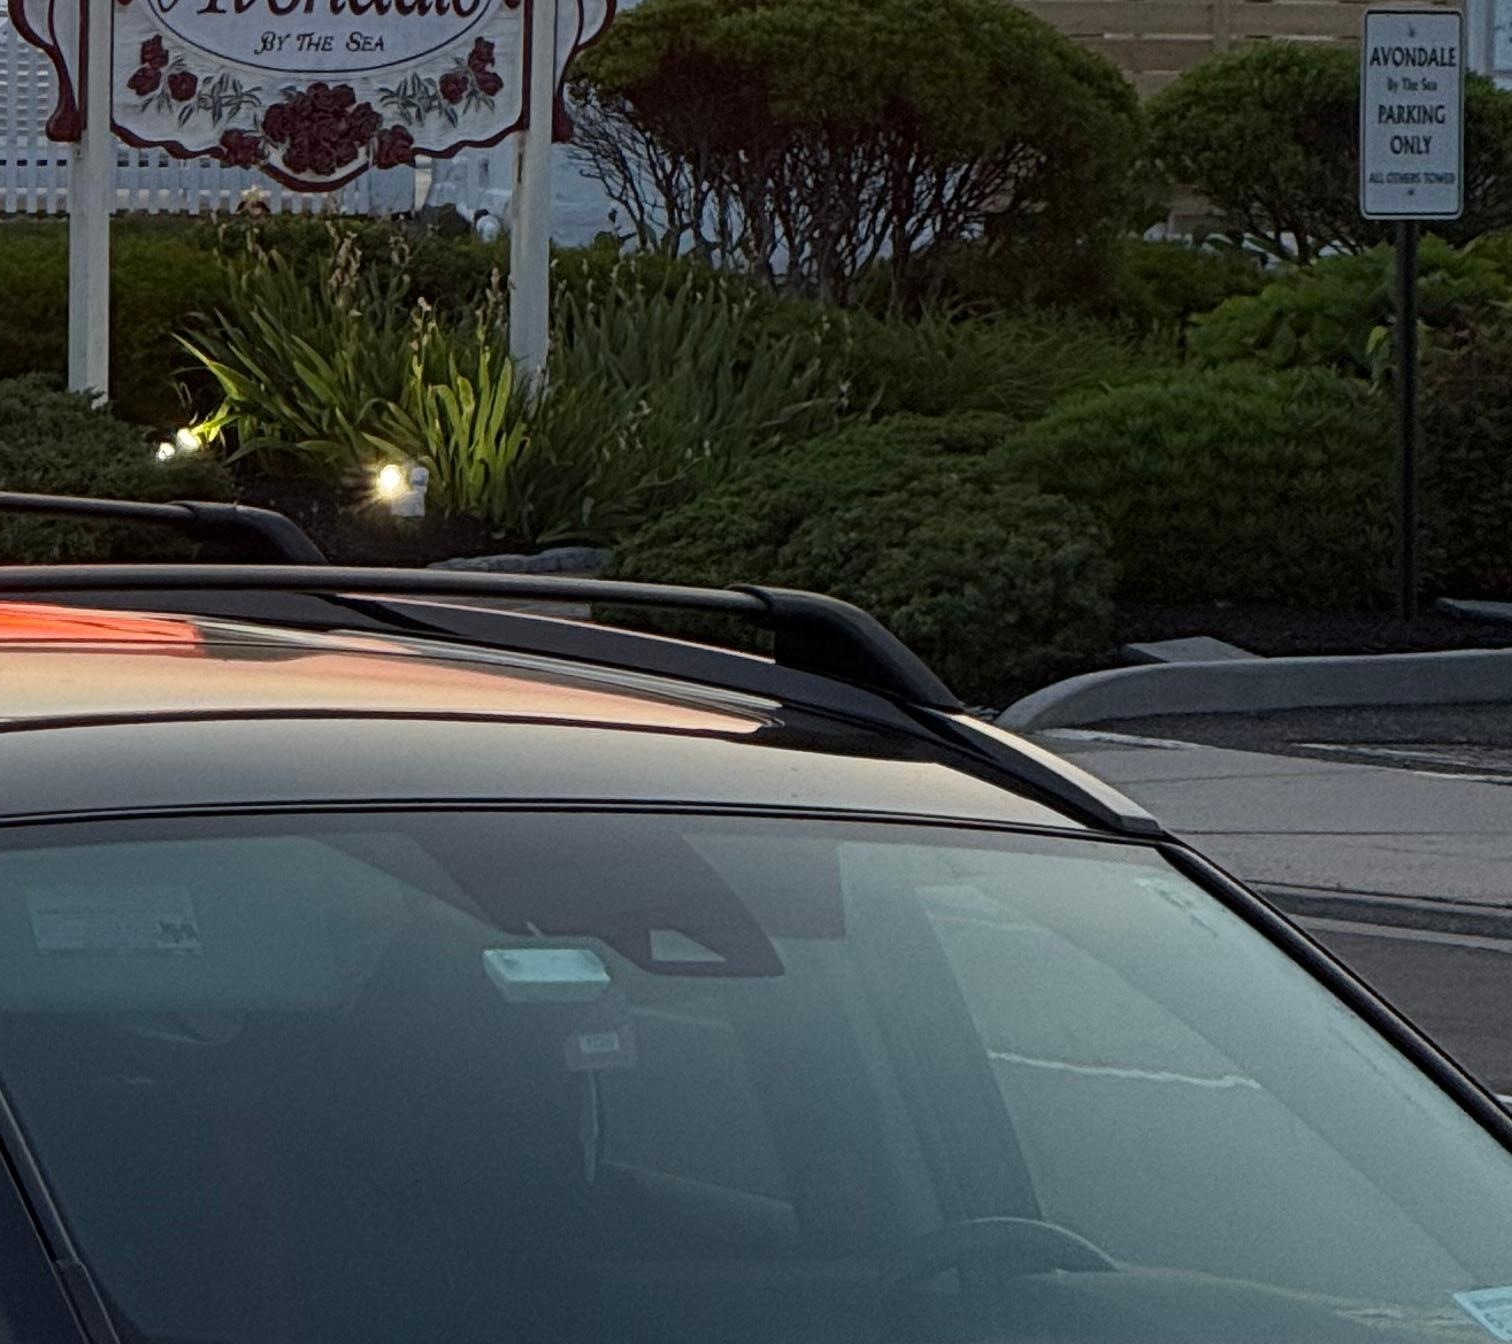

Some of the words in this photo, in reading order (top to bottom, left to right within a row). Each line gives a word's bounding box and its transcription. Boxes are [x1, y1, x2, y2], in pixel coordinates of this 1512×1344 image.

[1369, 46, 1457, 67] AVONDALE
[1402, 77, 1418, 91] The
[1378, 104, 1446, 124] PARKING
[1390, 135, 1433, 155] ONLY
[1368, 172, 1384, 184] ALL
[1386, 172, 1421, 184] OTHERS
[1423, 172, 1456, 184] TOWED
